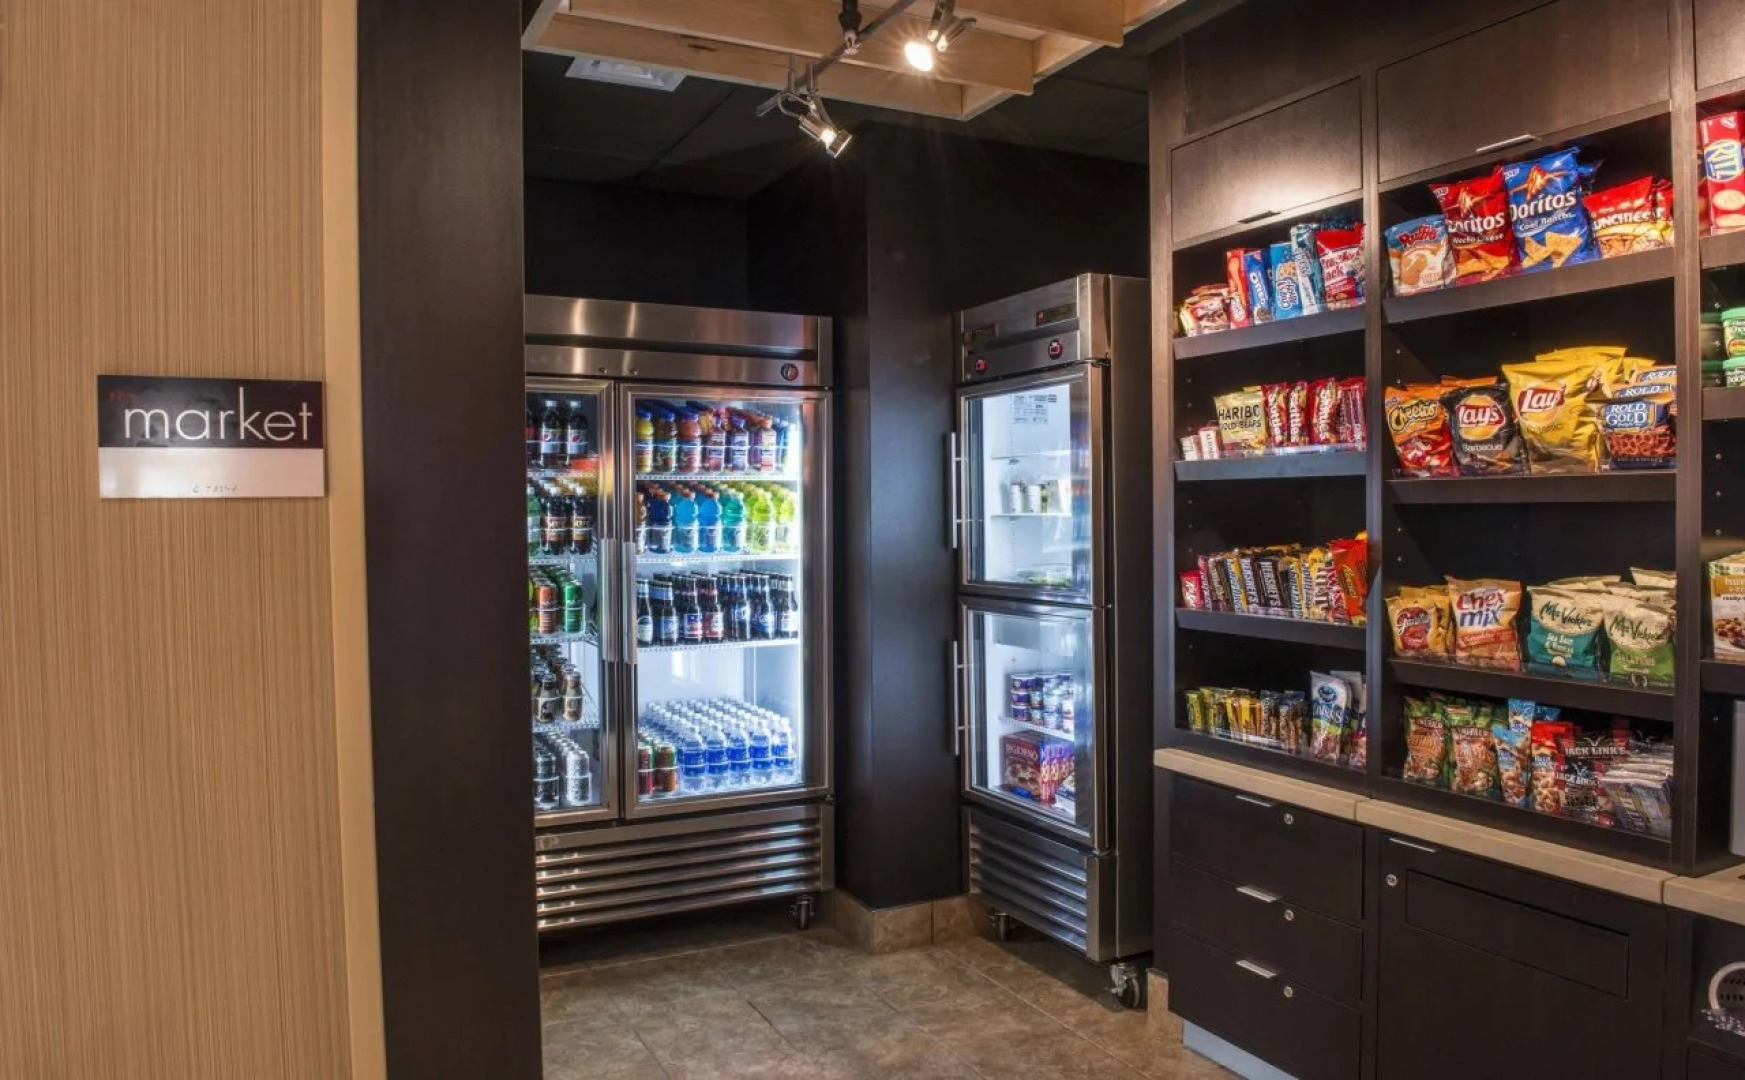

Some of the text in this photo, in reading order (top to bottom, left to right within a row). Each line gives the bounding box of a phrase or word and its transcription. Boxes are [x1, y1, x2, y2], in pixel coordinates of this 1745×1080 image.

[124, 386, 313, 441] market
[1218, 404, 1261, 421] HARIBO
[1606, 411, 1647, 426] GOLD
[1611, 402, 1647, 418] ROLD
[1456, 590, 1505, 611] Chex
[1460, 605, 1502, 627] mix
[1564, 747, 1589, 756] JACK
